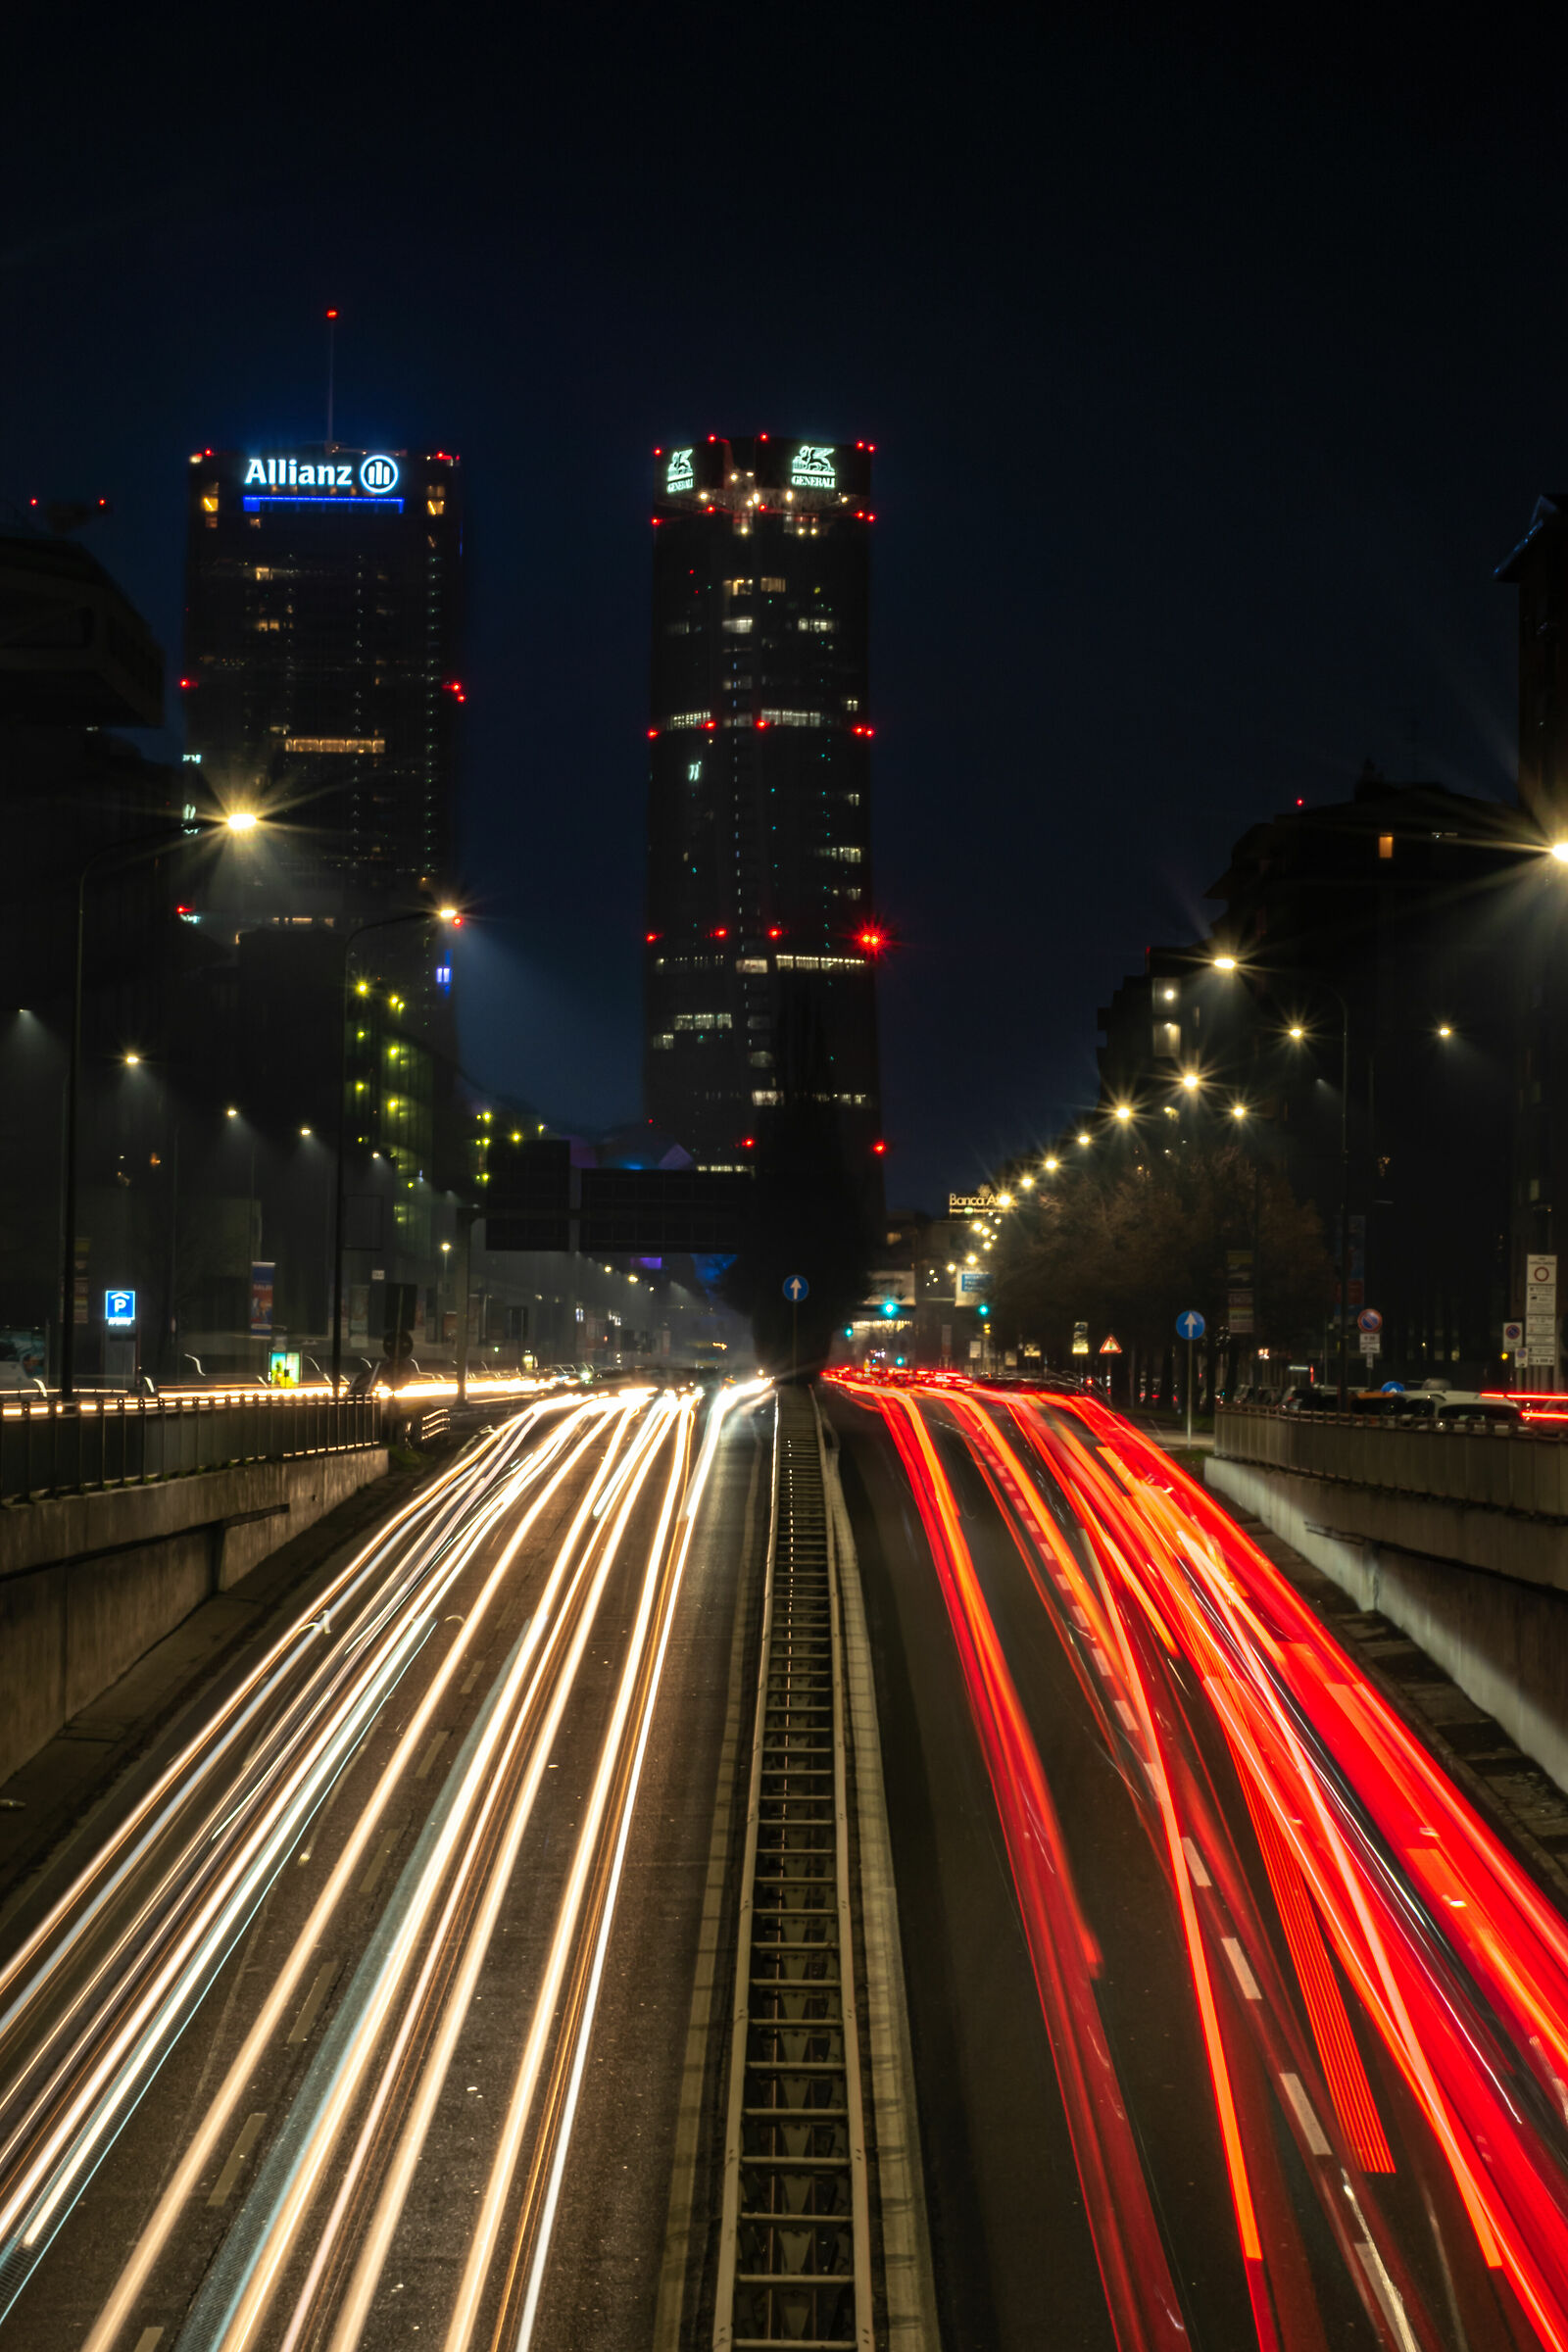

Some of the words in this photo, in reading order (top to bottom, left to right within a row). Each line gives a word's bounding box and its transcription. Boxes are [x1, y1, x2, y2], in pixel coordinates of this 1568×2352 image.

[244, 459, 353, 485] Allianz
[667, 477, 694, 494] GENERALI
[791, 475, 836, 488] GENERALI
[950, 1193, 985, 1205] Banca
[115, 1298, 126, 1312] P
